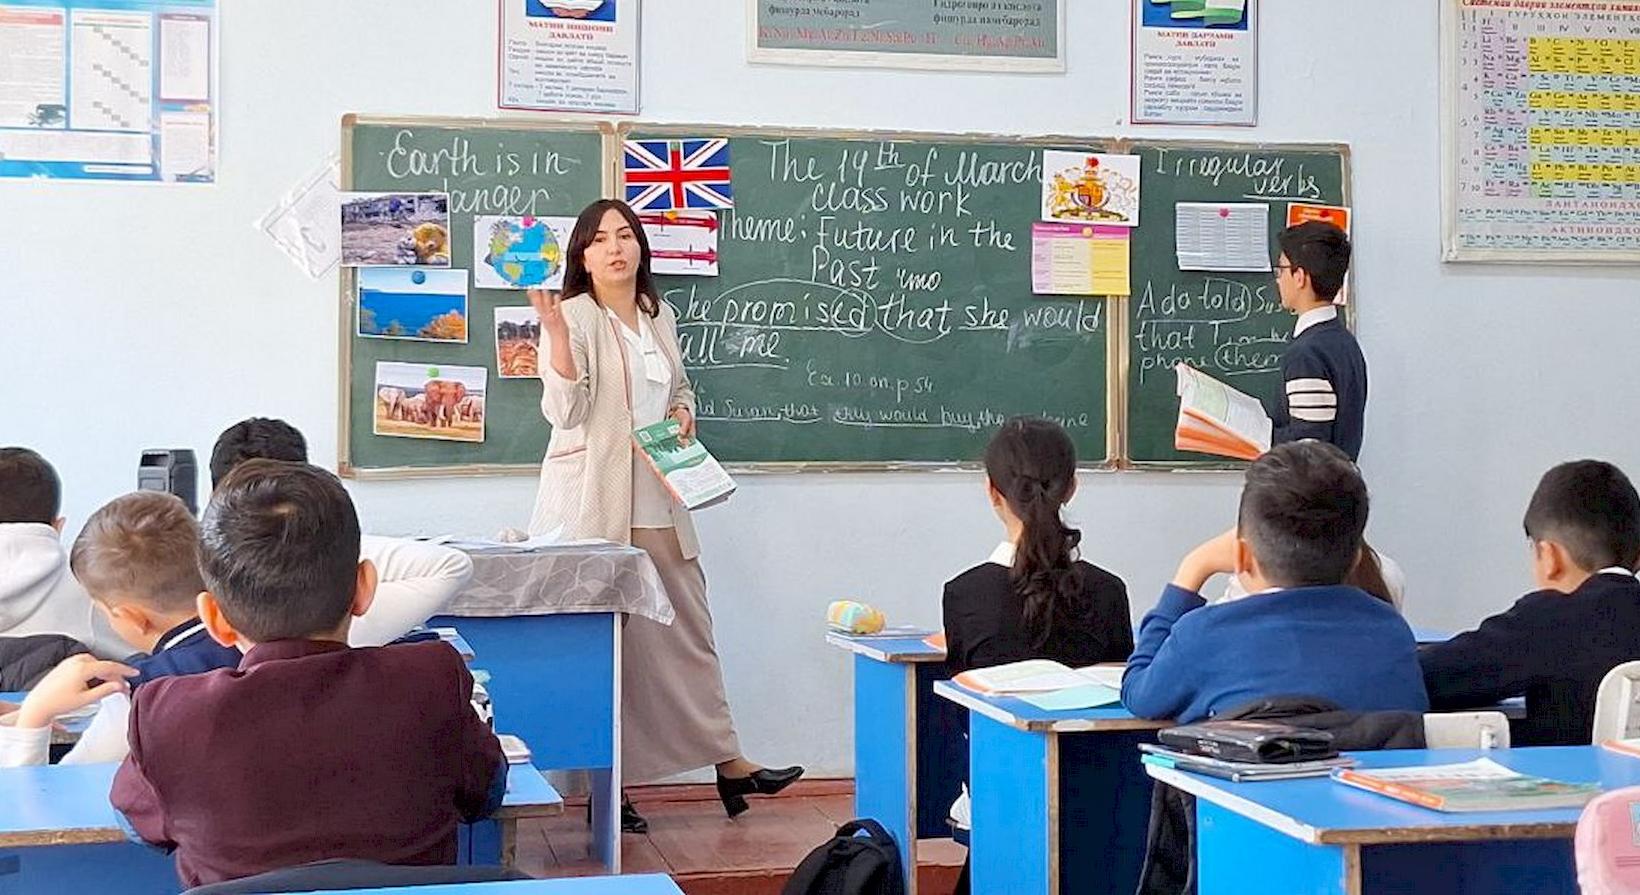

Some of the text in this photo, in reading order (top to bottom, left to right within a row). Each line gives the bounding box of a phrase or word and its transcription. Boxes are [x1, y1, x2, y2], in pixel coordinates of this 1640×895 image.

[387, 129, 486, 178] Earth
[496, 142, 521, 176] is
[760, 139, 823, 183] The
[905, 148, 938, 187] of
[945, 149, 1044, 188] March
[1156, 148, 1321, 199] Irregular verbs
[900, 184, 972, 218] work
[817, 216, 919, 253] Future
[929, 222, 959, 250] in
[969, 221, 1017, 251] the
[811, 247, 881, 289] Past
[664, 284, 1102, 338] She promised that she would
[1136, 320, 1195, 352] that
